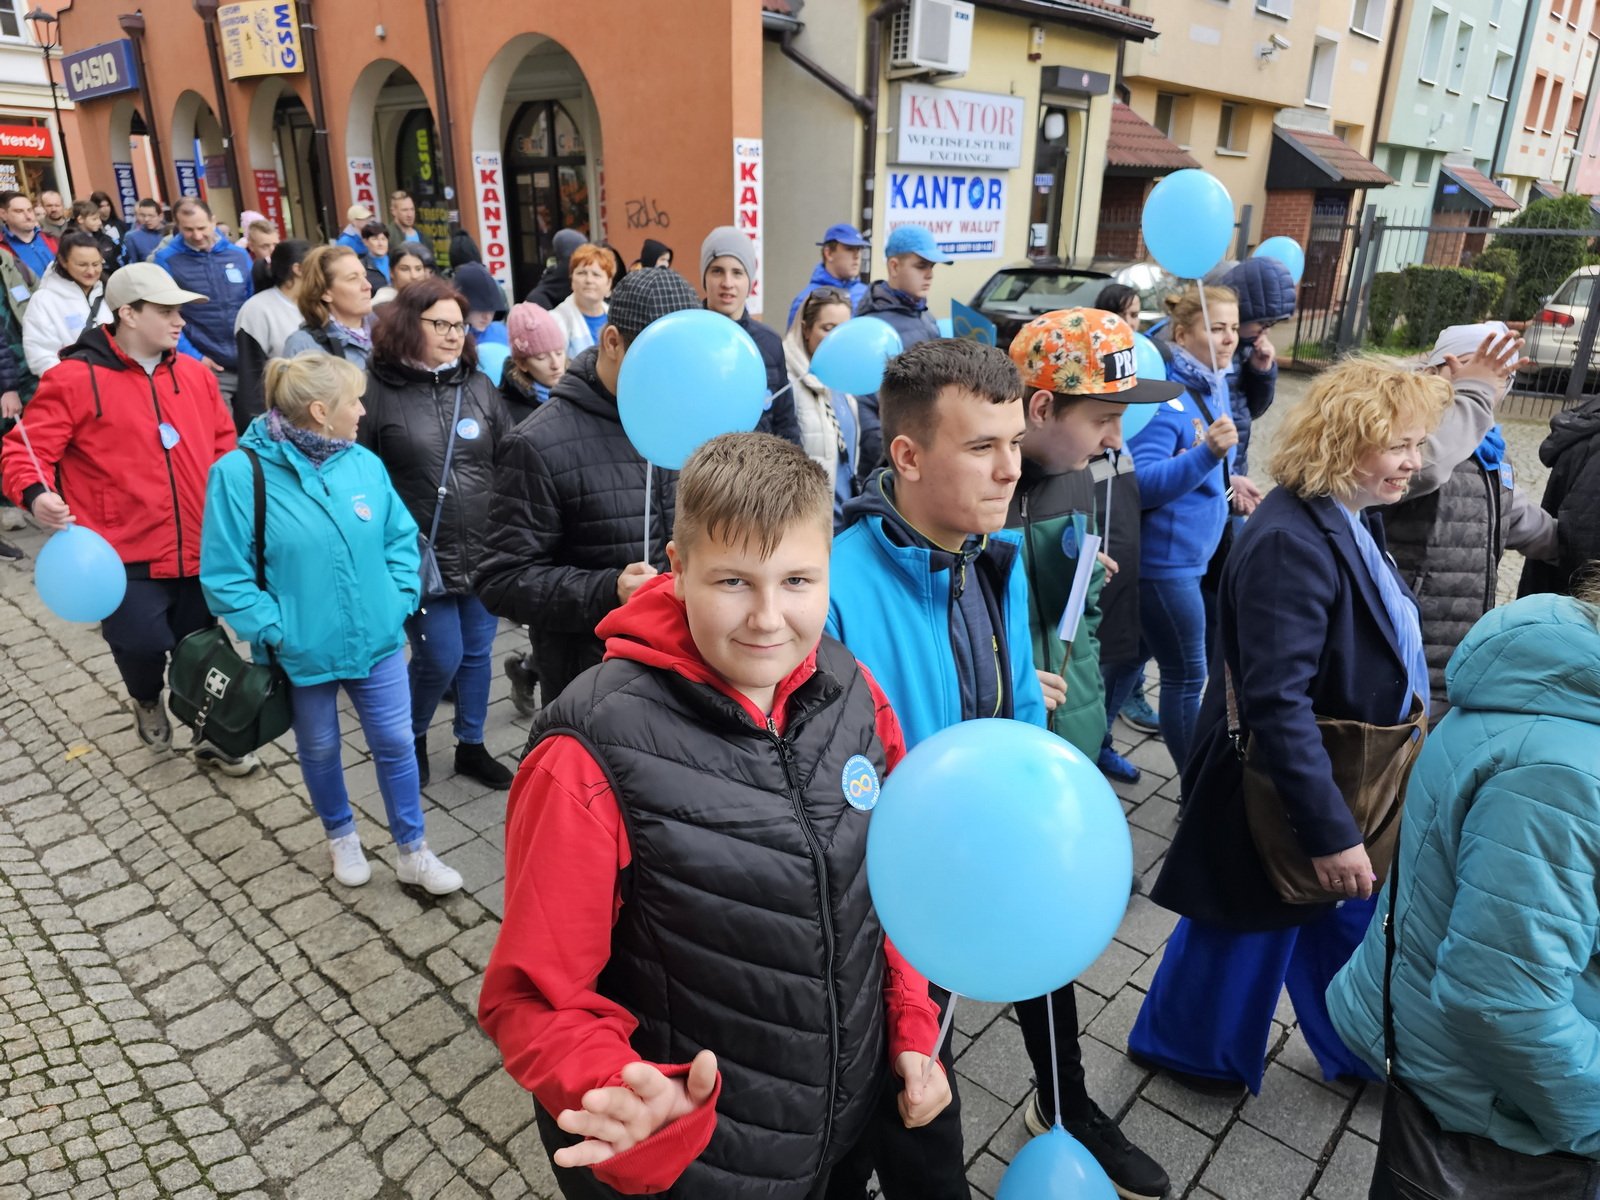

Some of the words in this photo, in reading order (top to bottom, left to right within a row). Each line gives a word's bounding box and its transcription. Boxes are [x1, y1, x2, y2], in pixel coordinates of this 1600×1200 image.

[273, 3, 297, 69] GSM
[70, 52, 118, 92] CASIO
[908, 95, 1014, 137] KANTOR
[736, 144, 760, 157] Cent
[929, 150, 993, 163] EXCHANGE
[891, 173, 1002, 210] KANTOR
[959, 220, 1000, 233] WALUT
